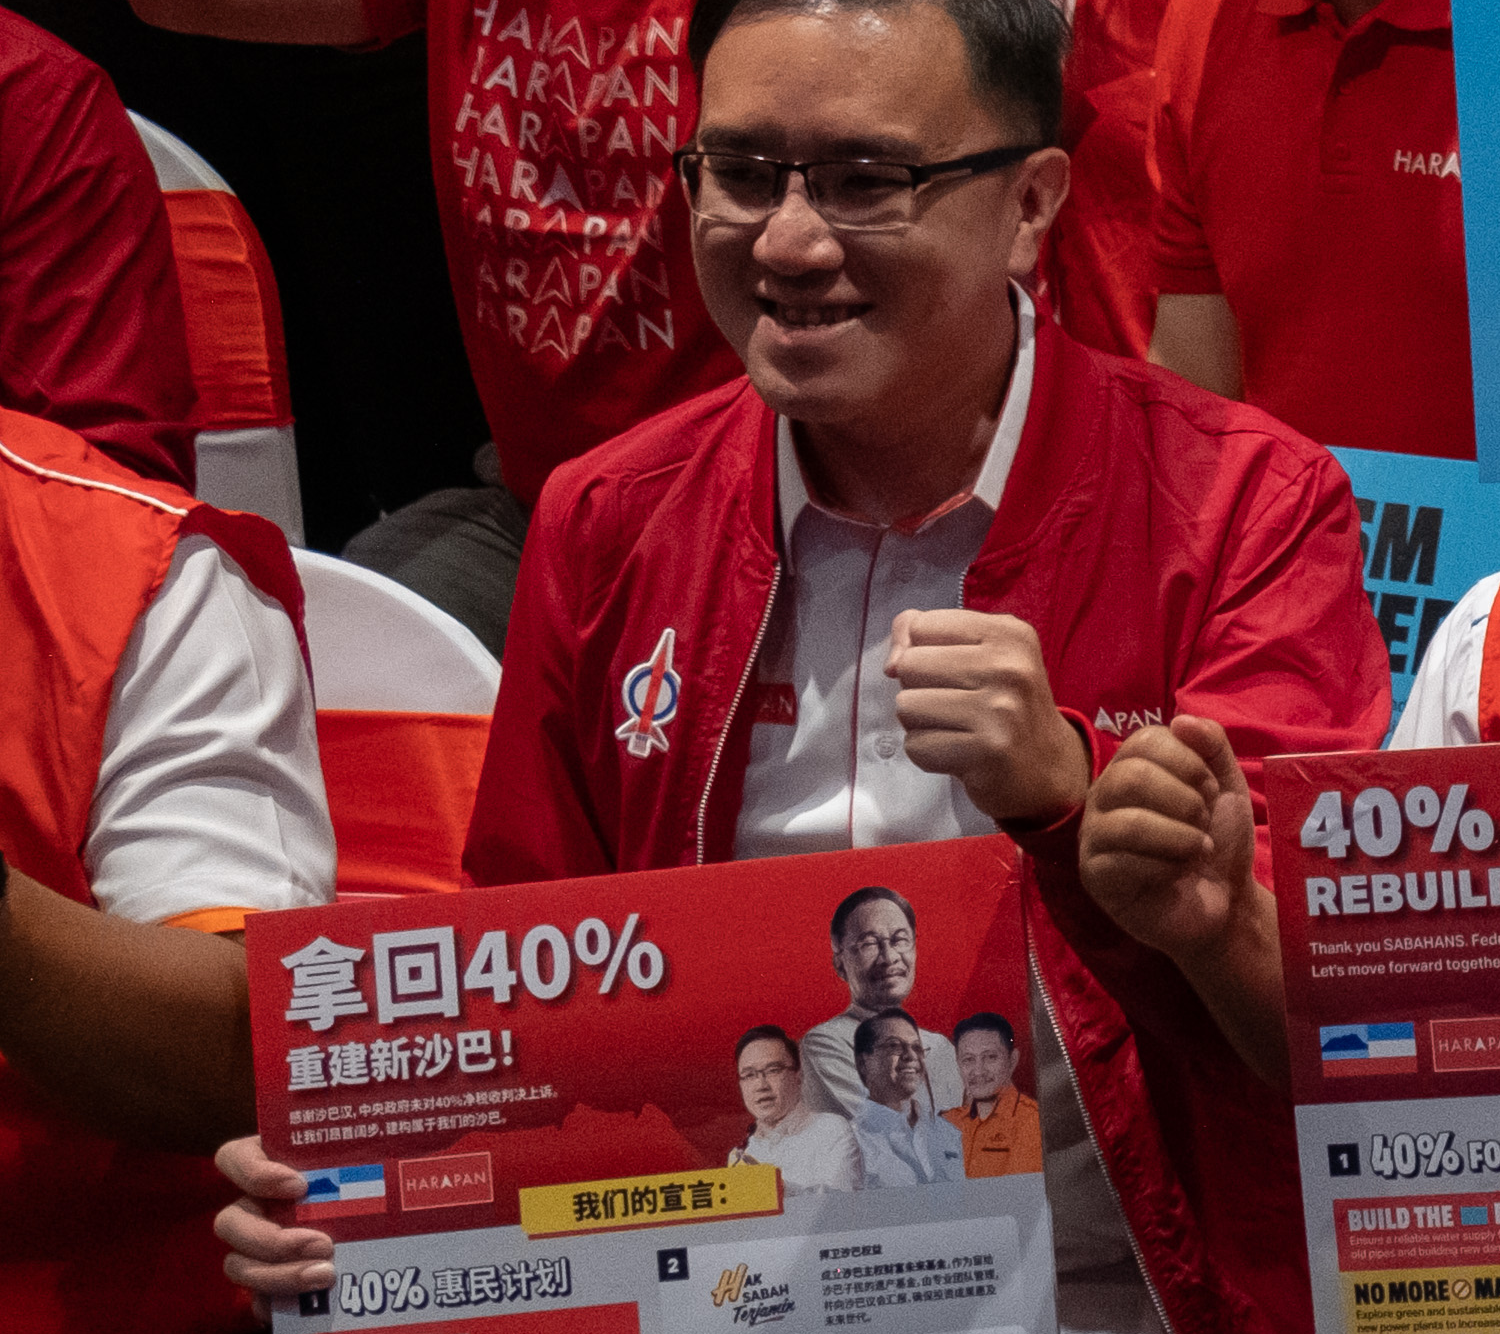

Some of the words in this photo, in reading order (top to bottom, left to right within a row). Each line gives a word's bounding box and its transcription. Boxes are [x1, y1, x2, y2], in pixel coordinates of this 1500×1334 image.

[1298, 783, 1495, 862] 40%
[1309, 941, 1351, 954] Thank
[1354, 941, 1381, 954] you
[1383, 933, 1467, 952] SABAHANS.
[280, 912, 664, 1032] 拿回40%
[285, 1029, 516, 1094] 重建新沙巴!
[1370, 1132, 1463, 1179] 40%
[406, 1171, 487, 1192] HARAPAN
[572, 1178, 731, 1222] 我们的宣言:
[1348, 1207, 1410, 1232] BUILD
[1414, 1206, 1454, 1227] THE
[340, 1267, 429, 1315] 40%
[434, 1258, 571, 1308] 惠民计划
[1354, 1283, 1384, 1305] NO
[1389, 1279, 1449, 1303] MORE
